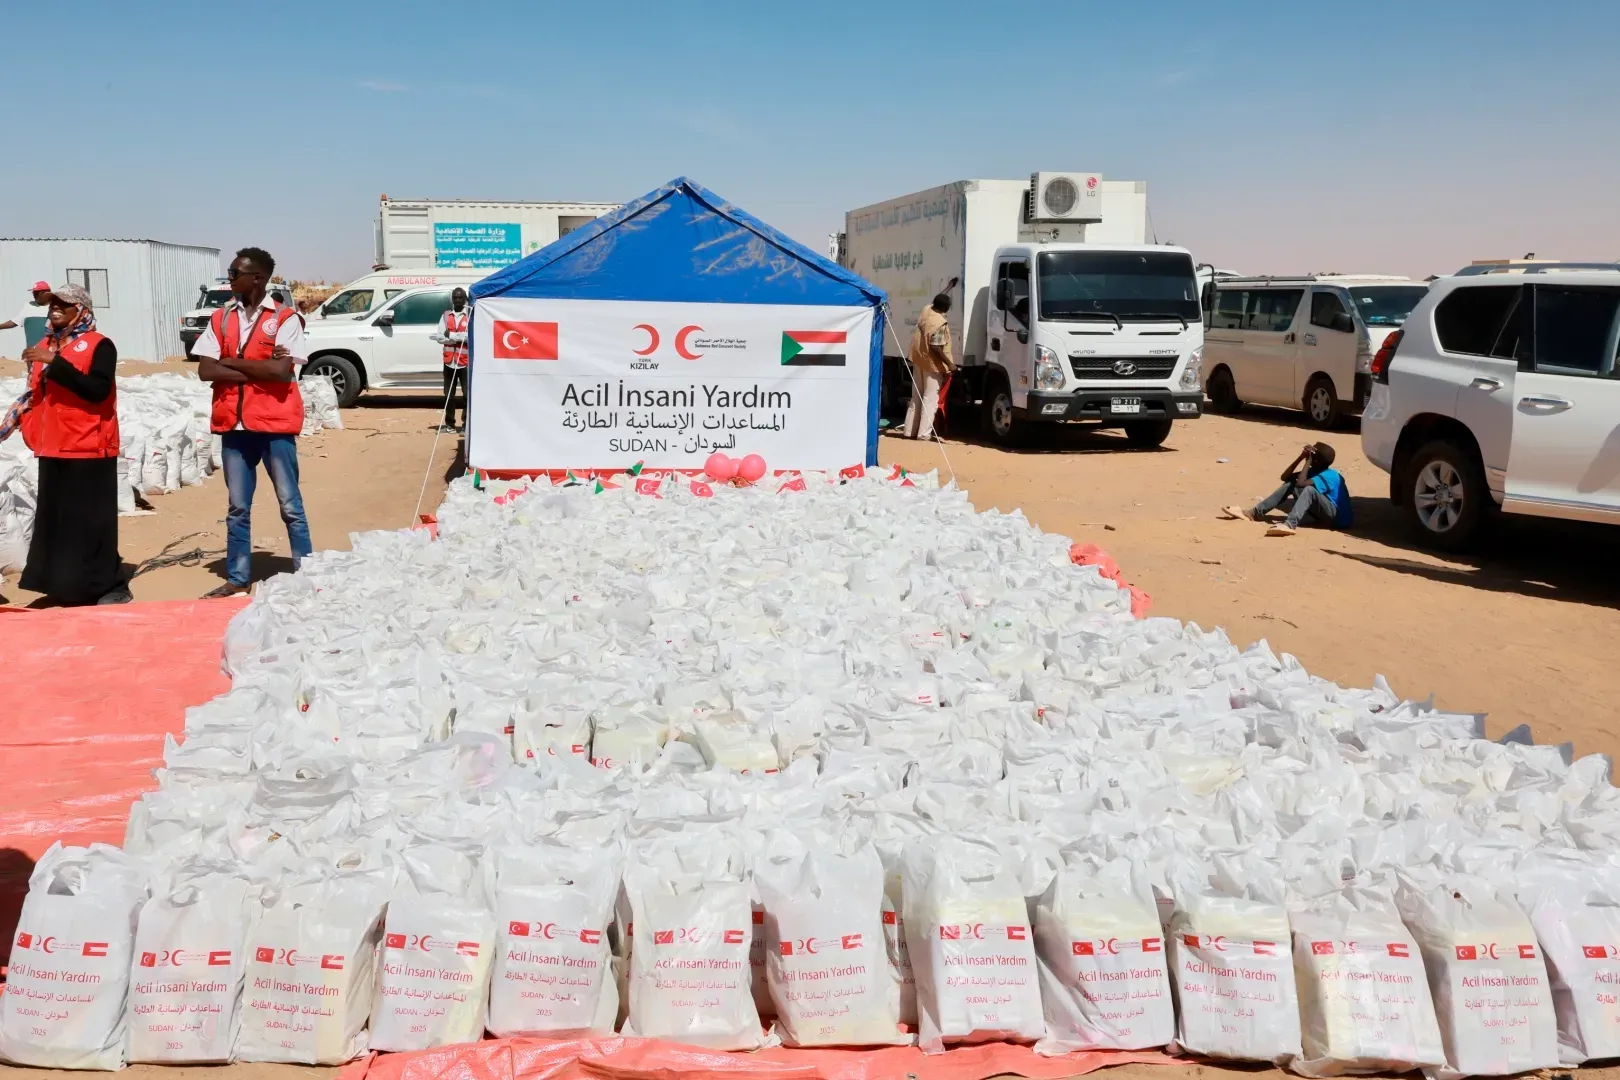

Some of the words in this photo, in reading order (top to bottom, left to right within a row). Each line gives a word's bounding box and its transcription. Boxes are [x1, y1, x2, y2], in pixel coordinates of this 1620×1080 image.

[561, 383, 609, 407] Acil
[619, 380, 694, 407] İnsani
[702, 385, 791, 408] Yardım
[562, 410, 618, 432] الطارئة
[626, 411, 694, 434] الإنسانية
[702, 413, 785, 432] المساعدات
[609, 439, 667, 452] SUDAN
[684, 434, 736, 454] السودان
[508, 951, 526, 962] Acil
[529, 950, 560, 965] İnsani
[562, 956, 596, 968] Yardım
[709, 959, 741, 969] Yardım
[966, 953, 994, 966] İnsani
[996, 955, 1027, 966] Yardım
[10, 962, 25, 974] Acil
[27, 964, 58, 980] İnsani
[60, 971, 100, 983] Yardım
[384, 963, 401, 975] Acil
[405, 963, 435, 978] İnsani
[439, 969, 473, 982] Yardım
[798, 969, 828, 980] İnsani
[830, 964, 866, 976] Yardım
[1078, 971, 1096, 982] Acil
[1100, 968, 1128, 981] İnsani
[1130, 968, 1162, 979] Yardım
[1185, 961, 1204, 973] Acil
[1240, 968, 1277, 982] Yardım
[1462, 976, 1479, 987] Acil
[1482, 973, 1509, 986] İnsani
[1510, 974, 1538, 986] Yardım
[1595, 972, 1612, 983] Acil
[135, 982, 152, 993] Acil
[156, 981, 188, 993] İnsani
[192, 981, 227, 992] Yardım
[254, 978, 271, 988] Acil
[273, 978, 300, 993] İnsani
[304, 984, 339, 996] Yardım
